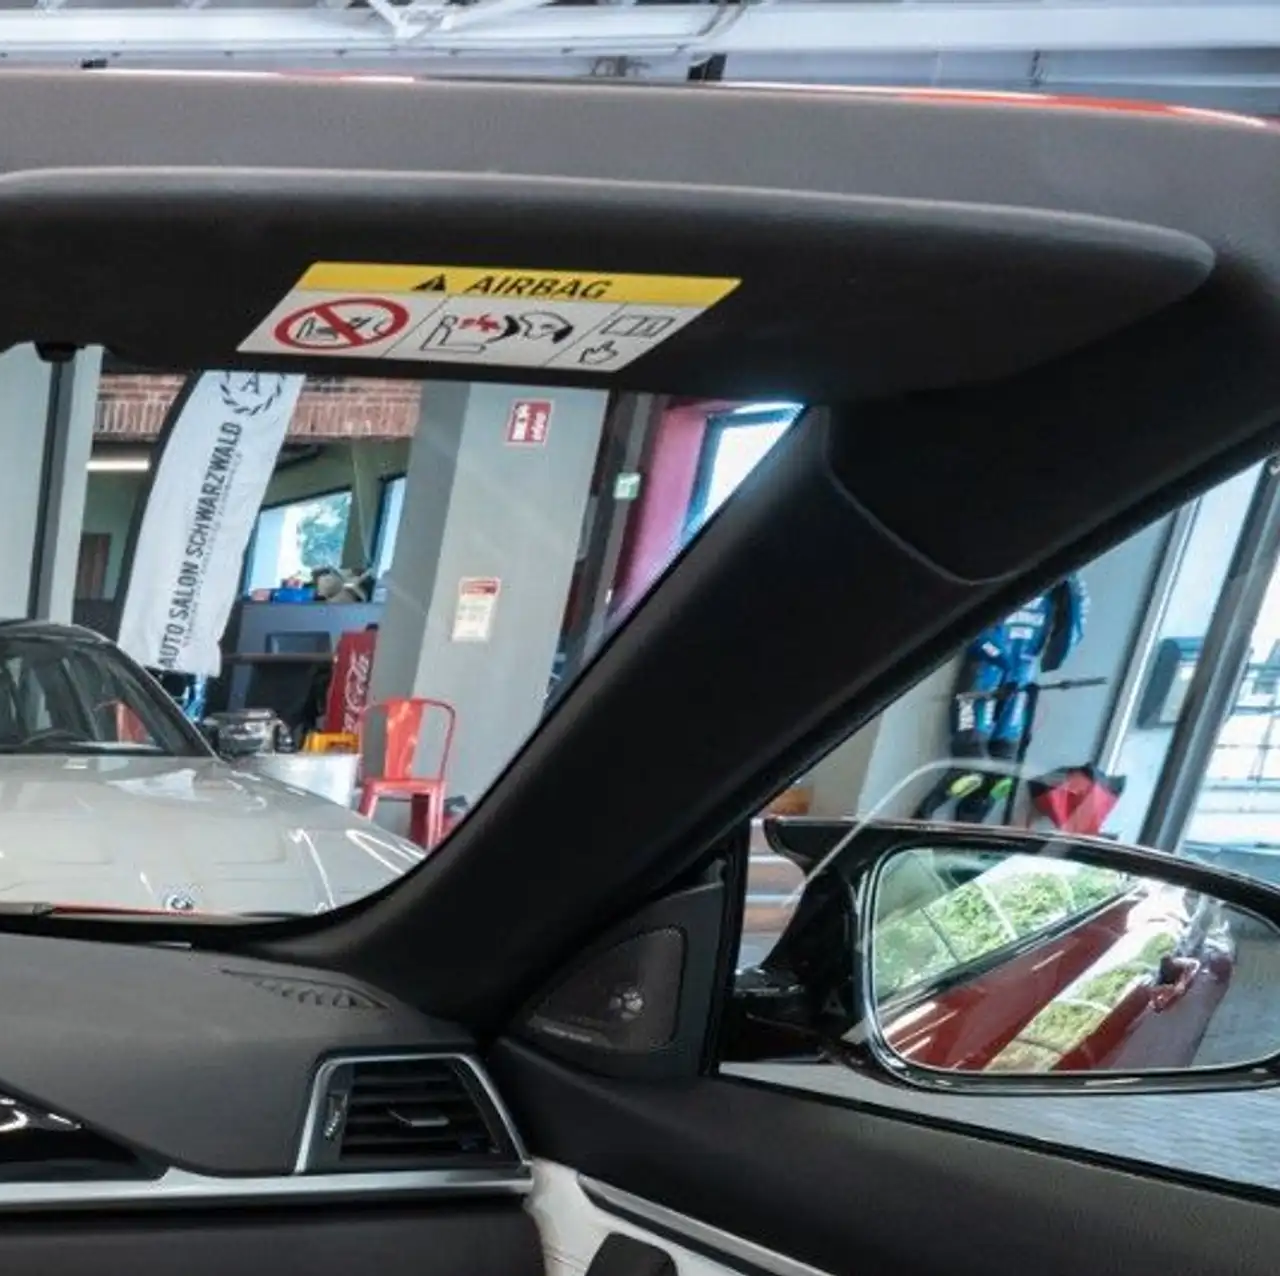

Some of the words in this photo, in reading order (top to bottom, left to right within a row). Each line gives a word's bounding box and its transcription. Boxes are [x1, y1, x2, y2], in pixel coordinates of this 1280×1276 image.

[469, 276, 613, 300] AIRBAG
[185, 421, 242, 558] SCHWARZWALD
[169, 560, 199, 620] SALON
[157, 622, 185, 669] AUTO
